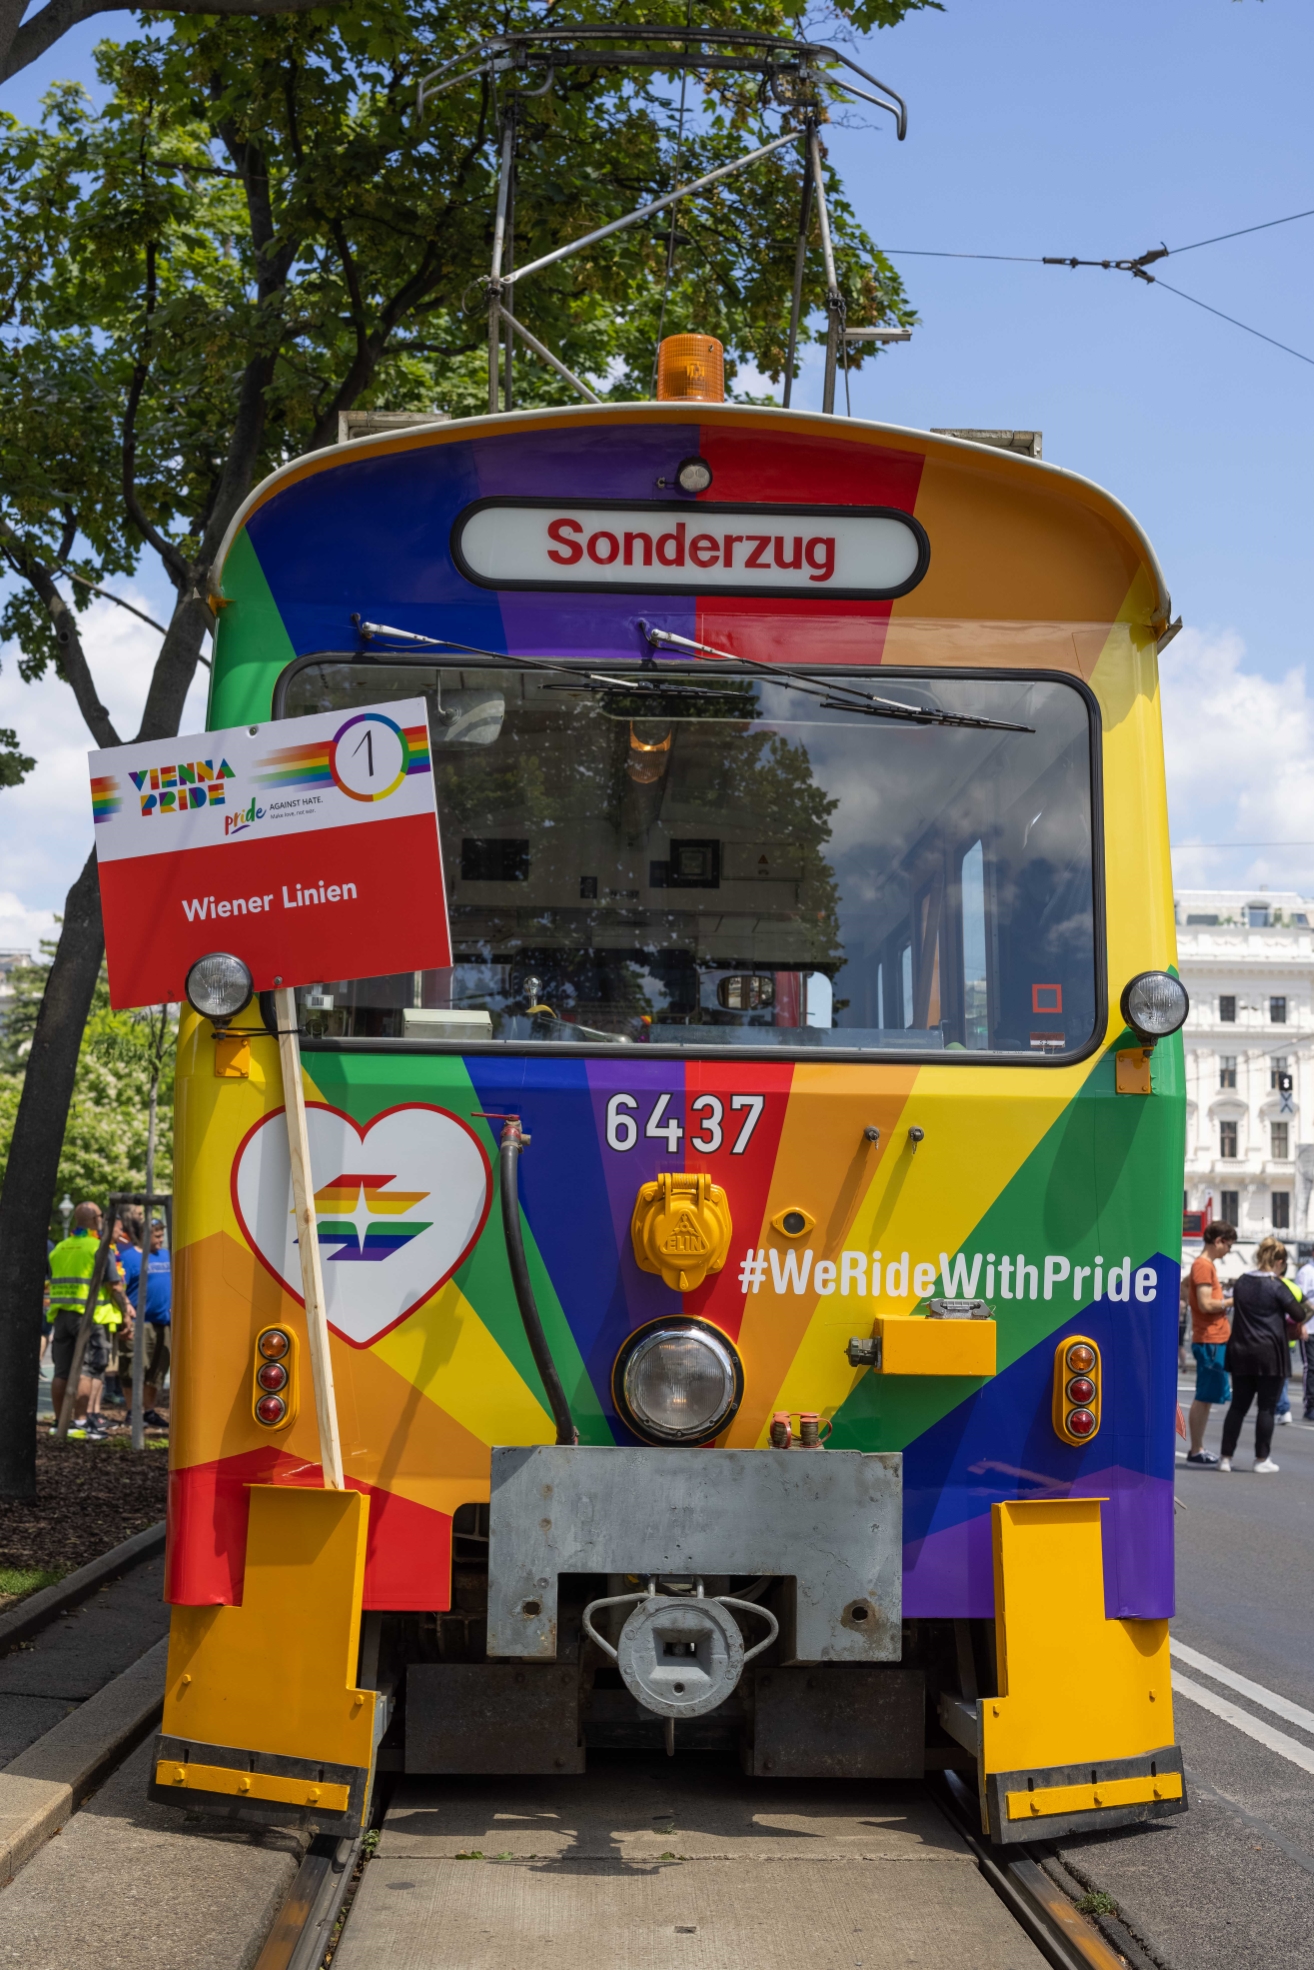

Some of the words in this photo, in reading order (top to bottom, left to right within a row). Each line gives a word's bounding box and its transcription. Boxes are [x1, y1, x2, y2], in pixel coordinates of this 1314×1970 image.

[547, 518, 836, 582] Sonderzug
[351, 729, 375, 777] 1
[128, 758, 236, 792] VIENNA
[140, 783, 226, 817] PRIDE
[224, 796, 267, 836] pride
[269, 800, 301, 811] AGAINST
[182, 892, 273, 922] Wiener
[282, 880, 357, 908] Linien
[605, 1092, 766, 1155] 6437
[667, 1235, 704, 1252] ELIN
[738, 1248, 1158, 1302] #WeRideWithPride
